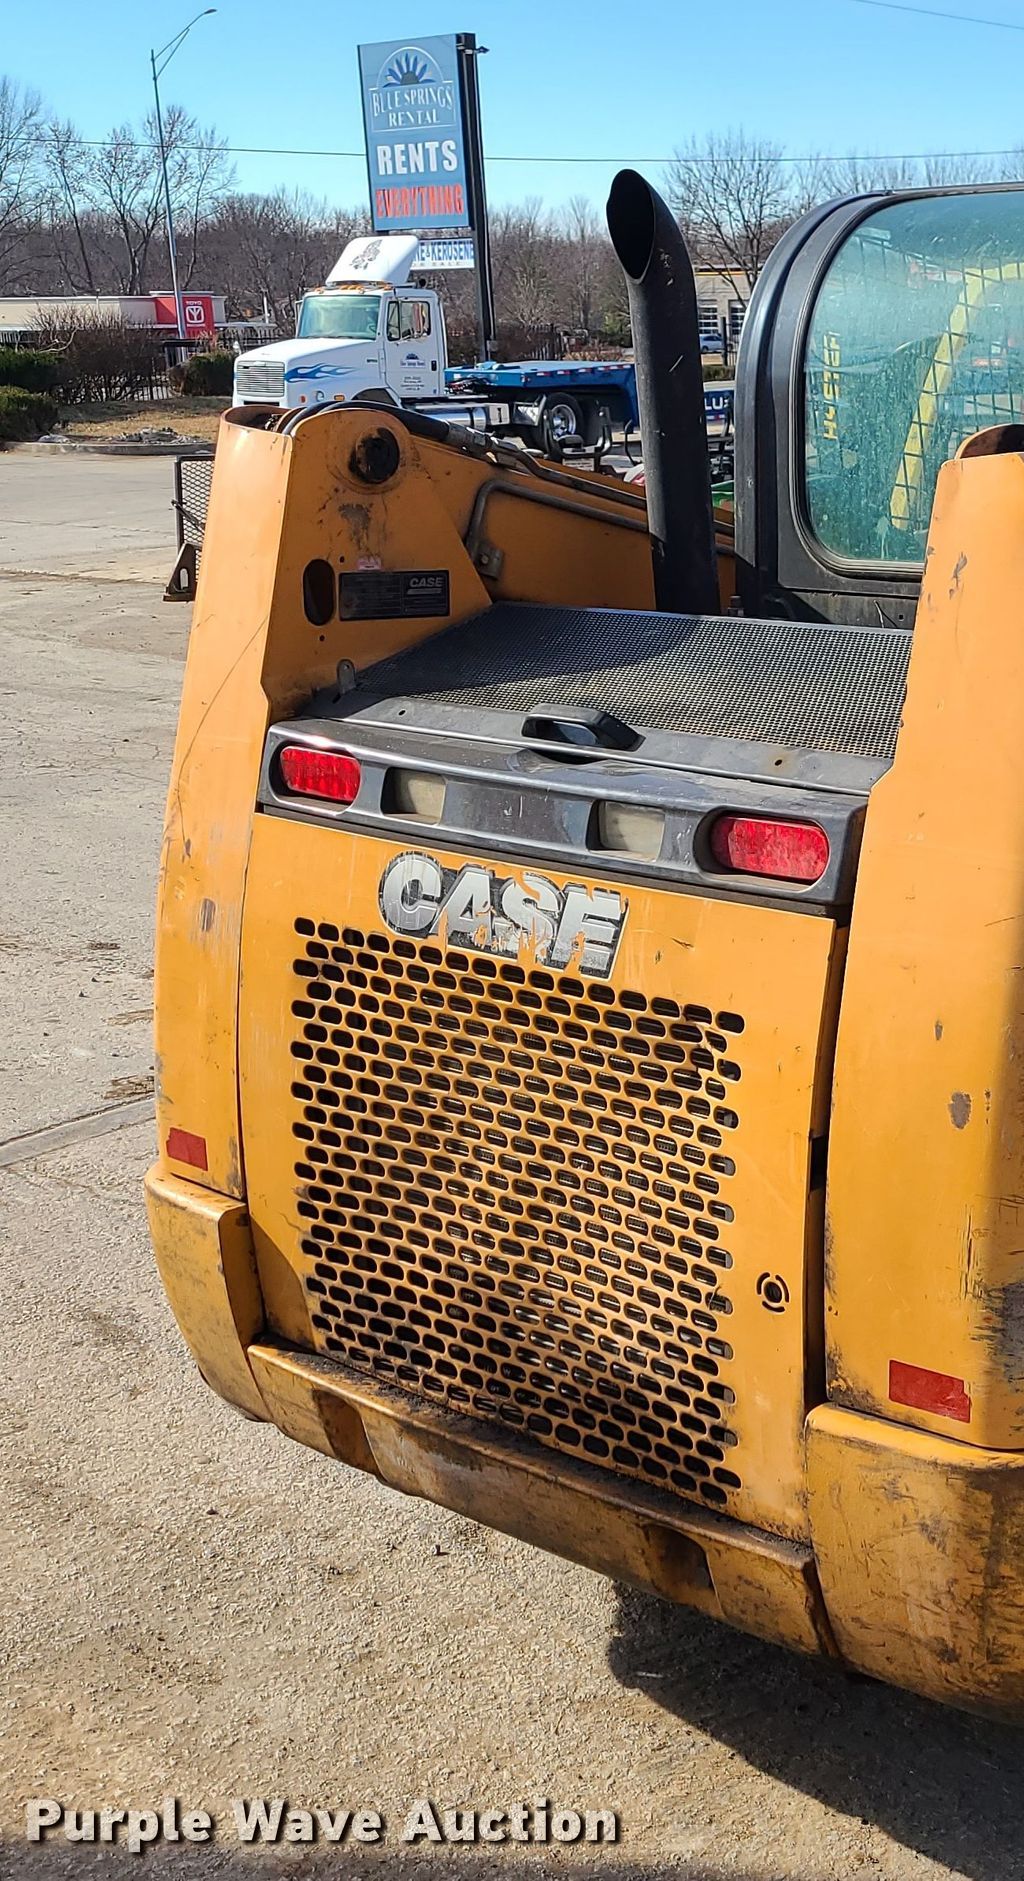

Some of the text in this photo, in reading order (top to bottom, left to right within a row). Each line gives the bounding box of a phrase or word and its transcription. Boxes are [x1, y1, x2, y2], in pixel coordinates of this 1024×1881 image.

[372, 86, 453, 117] BLUE SPRINGS
[389, 108, 440, 127] RENTAL
[376, 140, 458, 175] RENTS
[376, 183, 464, 217] EVERYTHING
[409, 577, 444, 588] CASE
[379, 850, 630, 982] CASE
